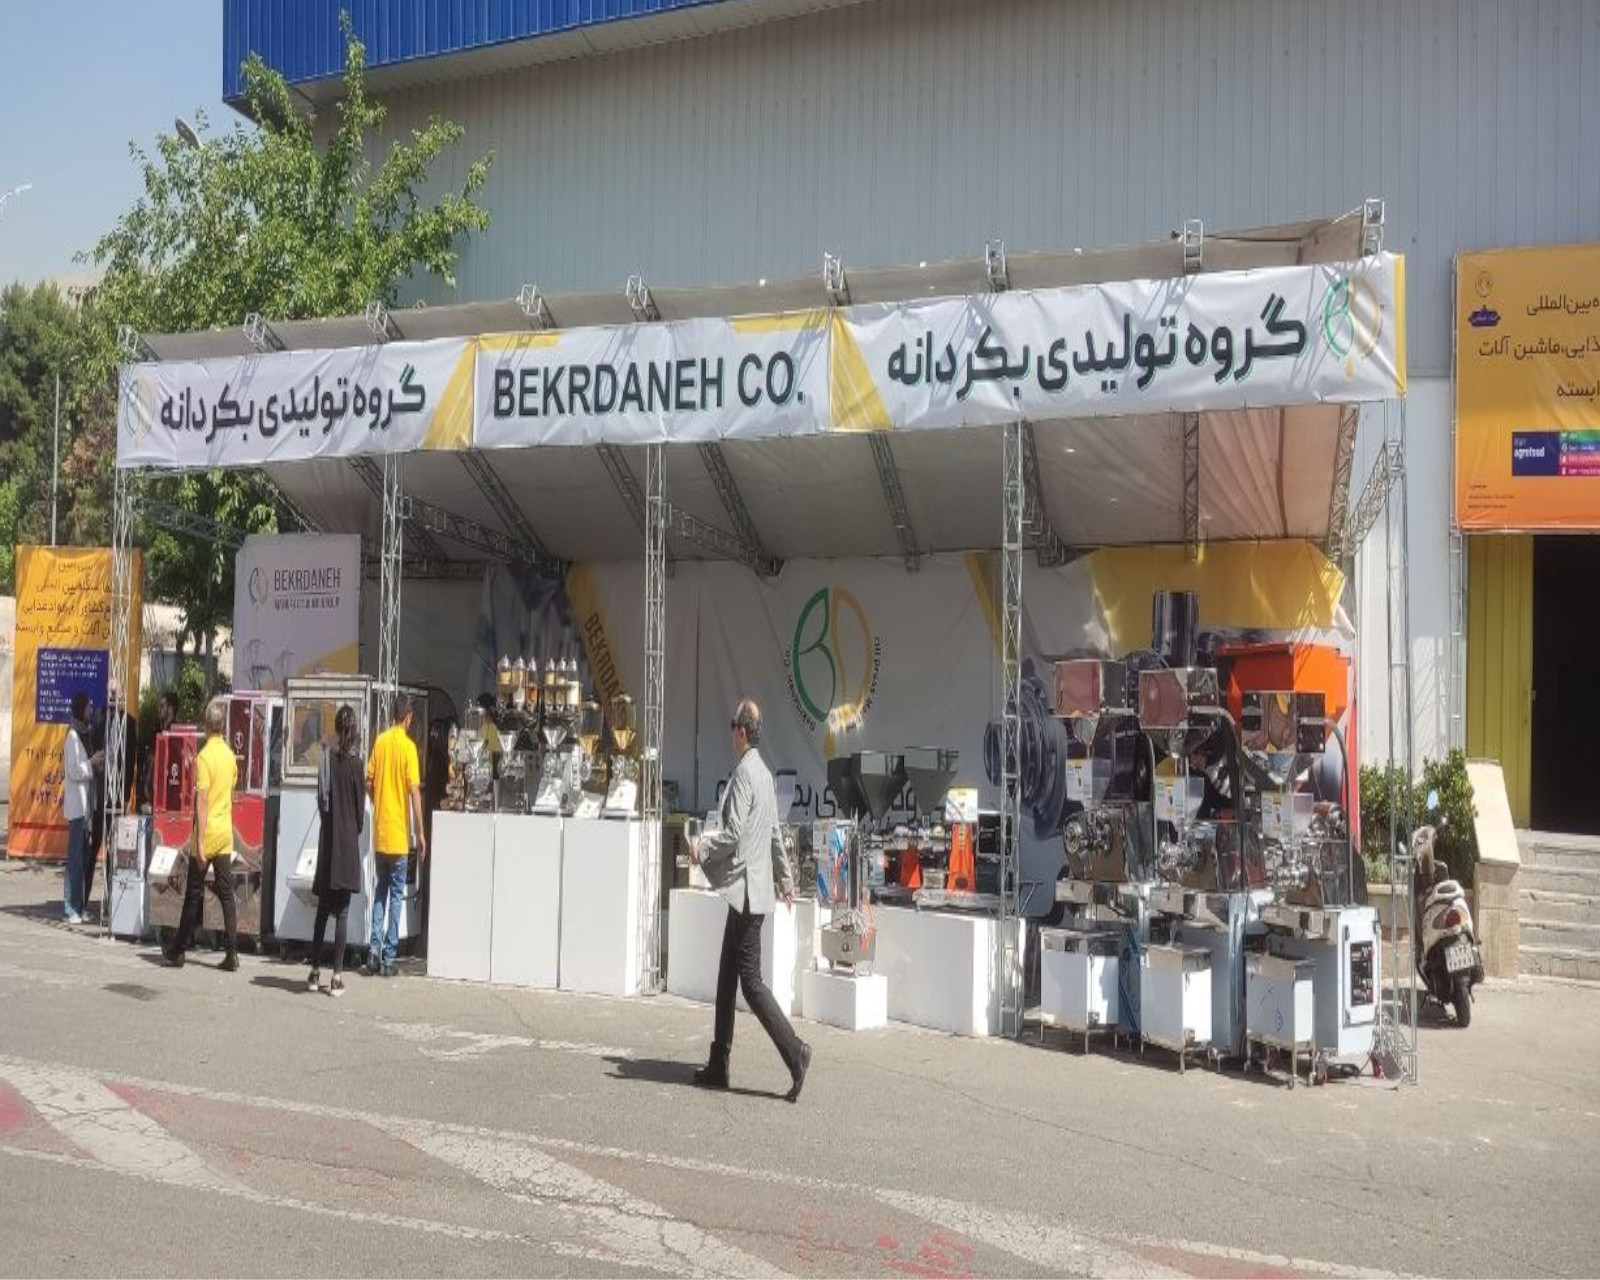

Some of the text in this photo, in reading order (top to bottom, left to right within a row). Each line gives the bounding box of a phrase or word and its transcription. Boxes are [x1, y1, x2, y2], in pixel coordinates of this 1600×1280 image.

[492, 351, 806, 418] BEKRDANEH CO.
[887, 292, 1307, 401] گروه تولیدی بکردانه
[160, 363, 426, 444] گروه تولیدی بکردانه
[274, 567, 341, 591] BEKRDANEH
[585, 612, 620, 699] BEKRDA
